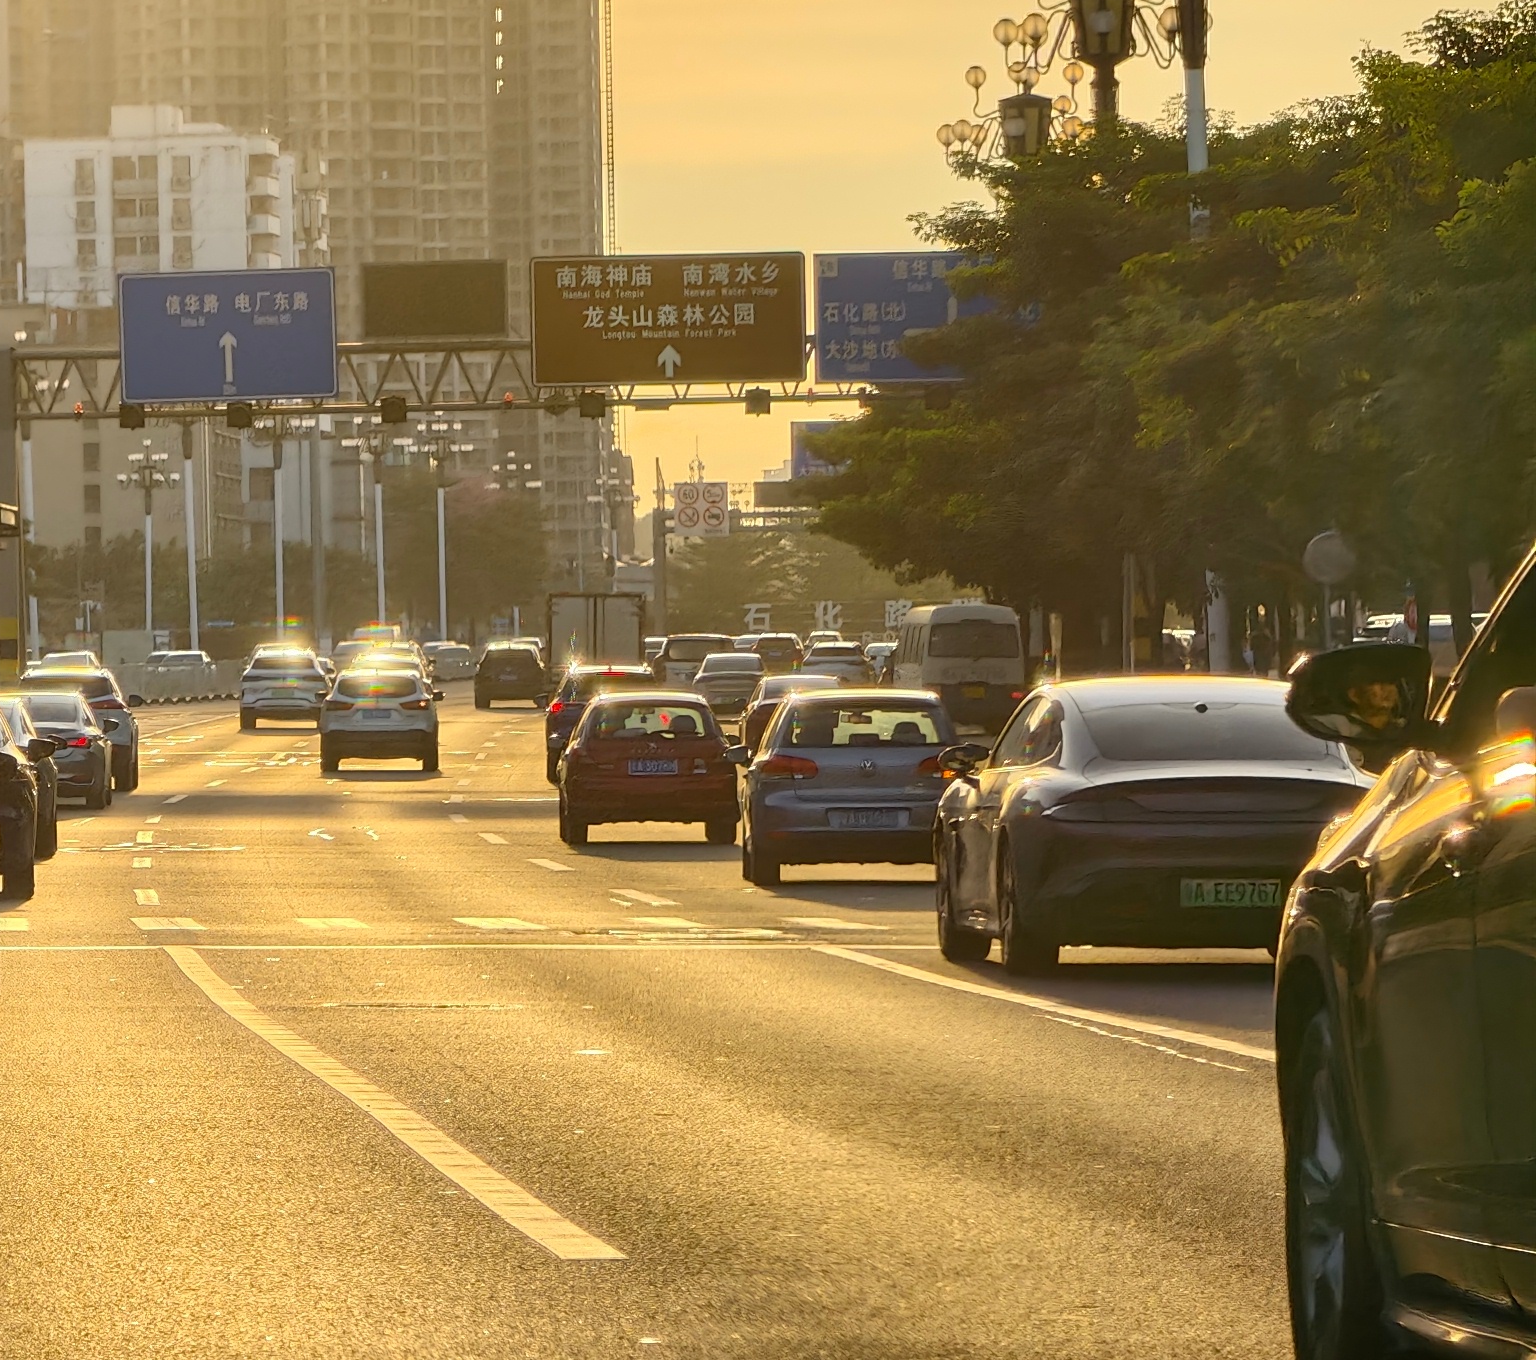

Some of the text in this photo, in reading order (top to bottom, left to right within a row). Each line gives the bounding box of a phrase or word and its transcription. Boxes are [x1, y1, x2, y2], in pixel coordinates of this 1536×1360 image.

[555, 263, 653, 289] 南海神庙
[682, 260, 780, 286] 南湾水乡
[166, 293, 219, 316] 信华路
[234, 291, 309, 313] 电厂东路
[581, 302, 756, 329] 龙头山森林公园
